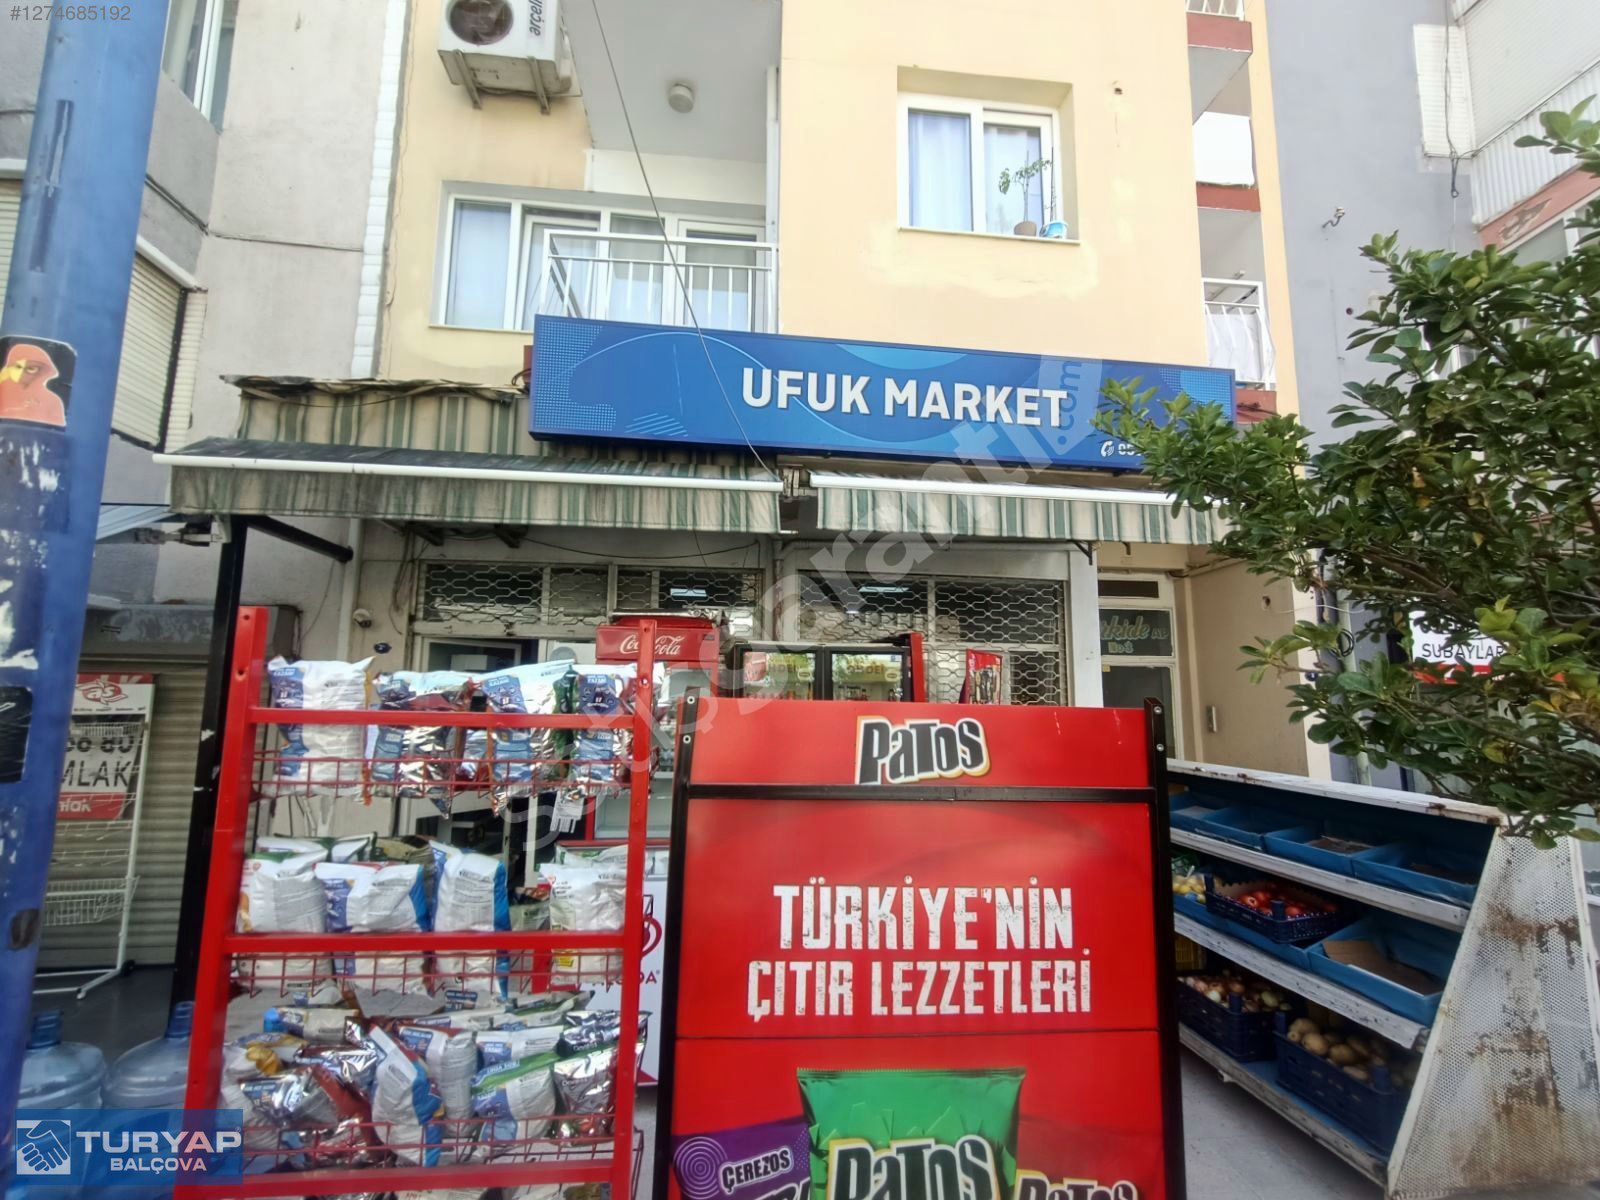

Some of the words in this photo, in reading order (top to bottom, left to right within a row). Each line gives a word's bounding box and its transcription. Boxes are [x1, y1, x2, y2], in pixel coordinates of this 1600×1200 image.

[528, 0, 545, 36] arçel
[742, 367, 870, 416] UFUK
[884, 377, 1068, 428] MARKET
[1118, 443, 1141, 456] 05
[773, 876, 1074, 950] TÜRKİYE'NİN
[747, 960, 854, 1022] ÇITIR
[871, 947, 1091, 1017] LEZZETLERİ
[720, 1148, 792, 1193] ÇEREZOS
